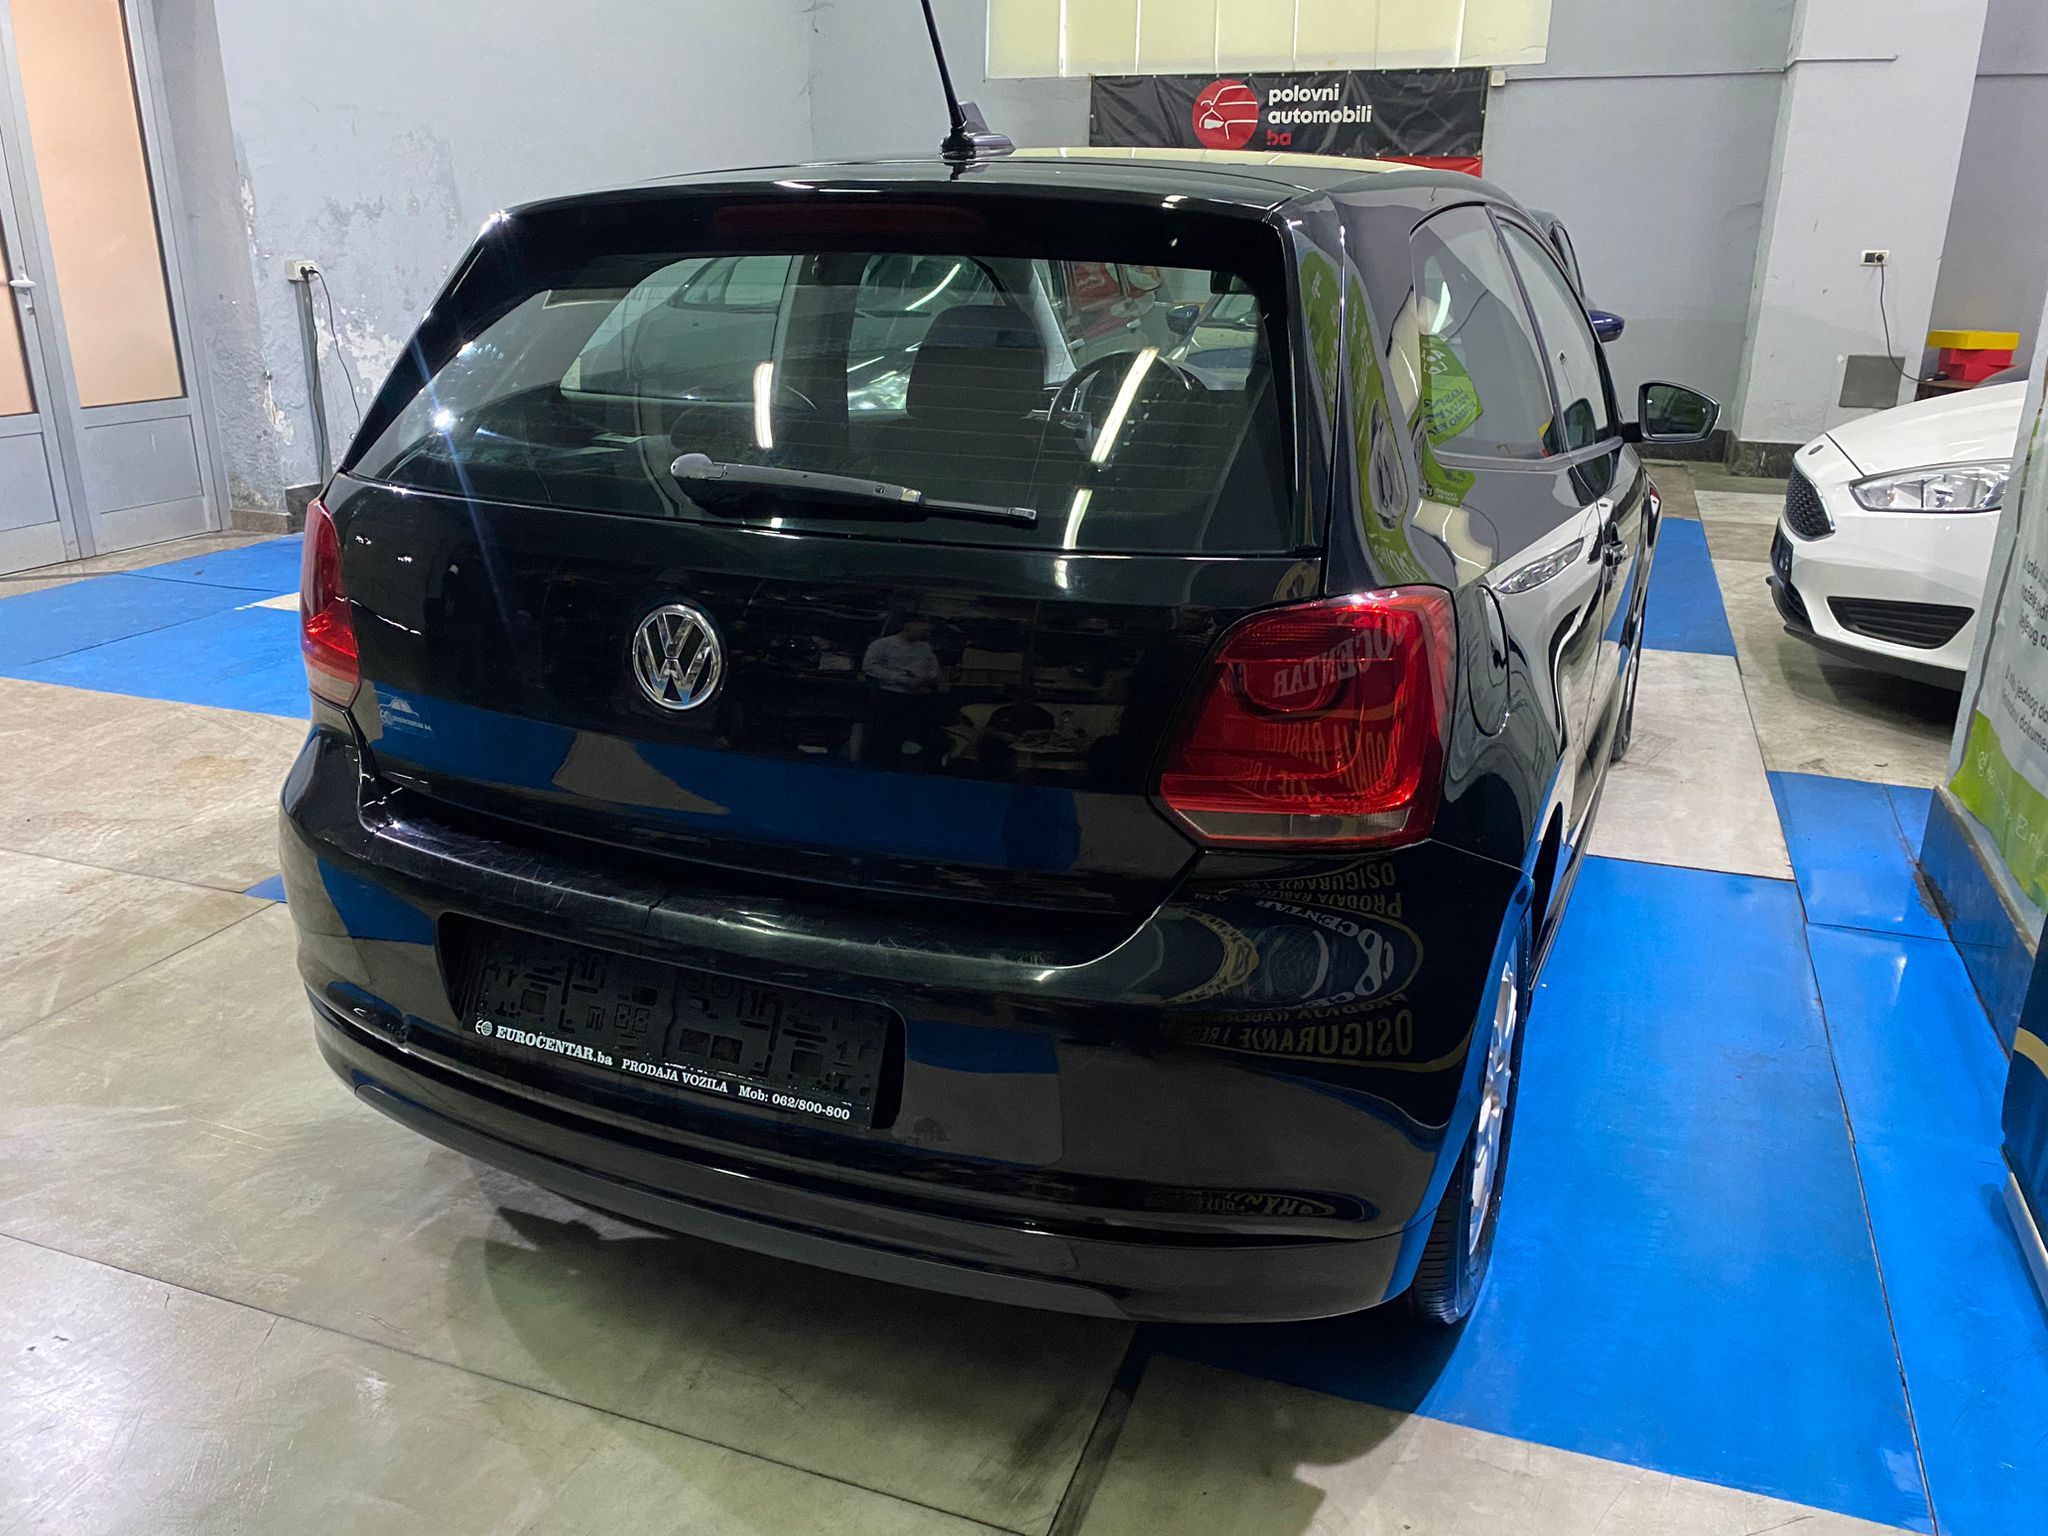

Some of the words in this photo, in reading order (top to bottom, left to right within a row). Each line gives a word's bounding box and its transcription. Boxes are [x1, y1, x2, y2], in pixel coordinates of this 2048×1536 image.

[1268, 83, 1340, 106] polovni
[1267, 104, 1372, 124] automobili
[495, 1025, 613, 1066] EUROCENTAR.ba
[621, 1058, 679, 1082] PRODAJA
[681, 1072, 728, 1093] VOZILA
[737, 1085, 769, 1102] Mob:
[771, 1093, 851, 1120] 062/800-800
